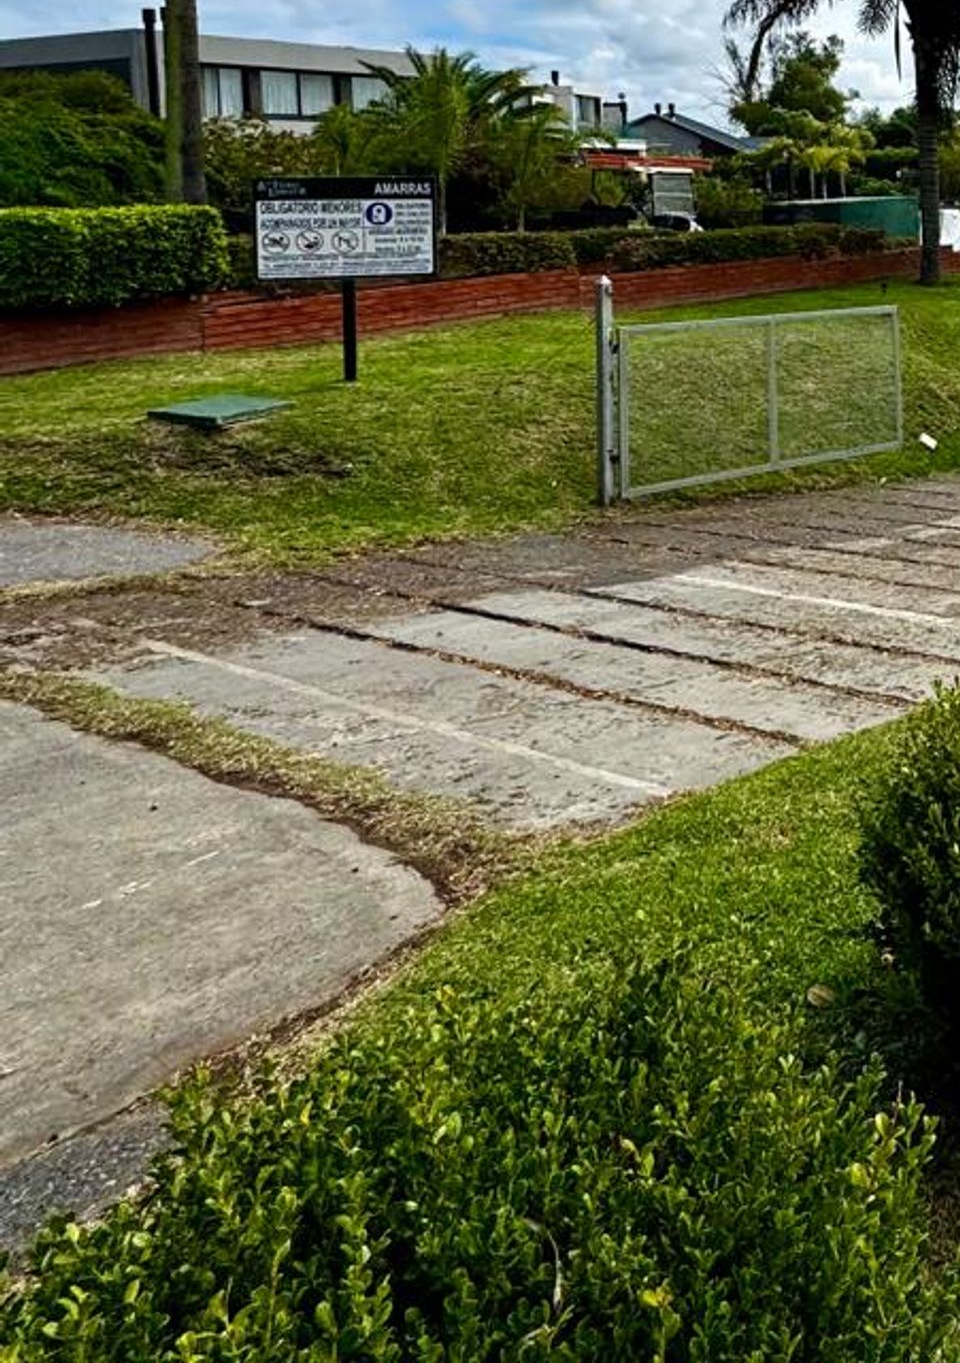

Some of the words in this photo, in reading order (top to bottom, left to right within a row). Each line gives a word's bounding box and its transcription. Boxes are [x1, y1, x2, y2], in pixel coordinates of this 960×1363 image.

[374, 182, 431, 195] AMARRAS
[261, 202, 317, 213] OBLIGATORIO
[321, 202, 360, 213] MENORES
